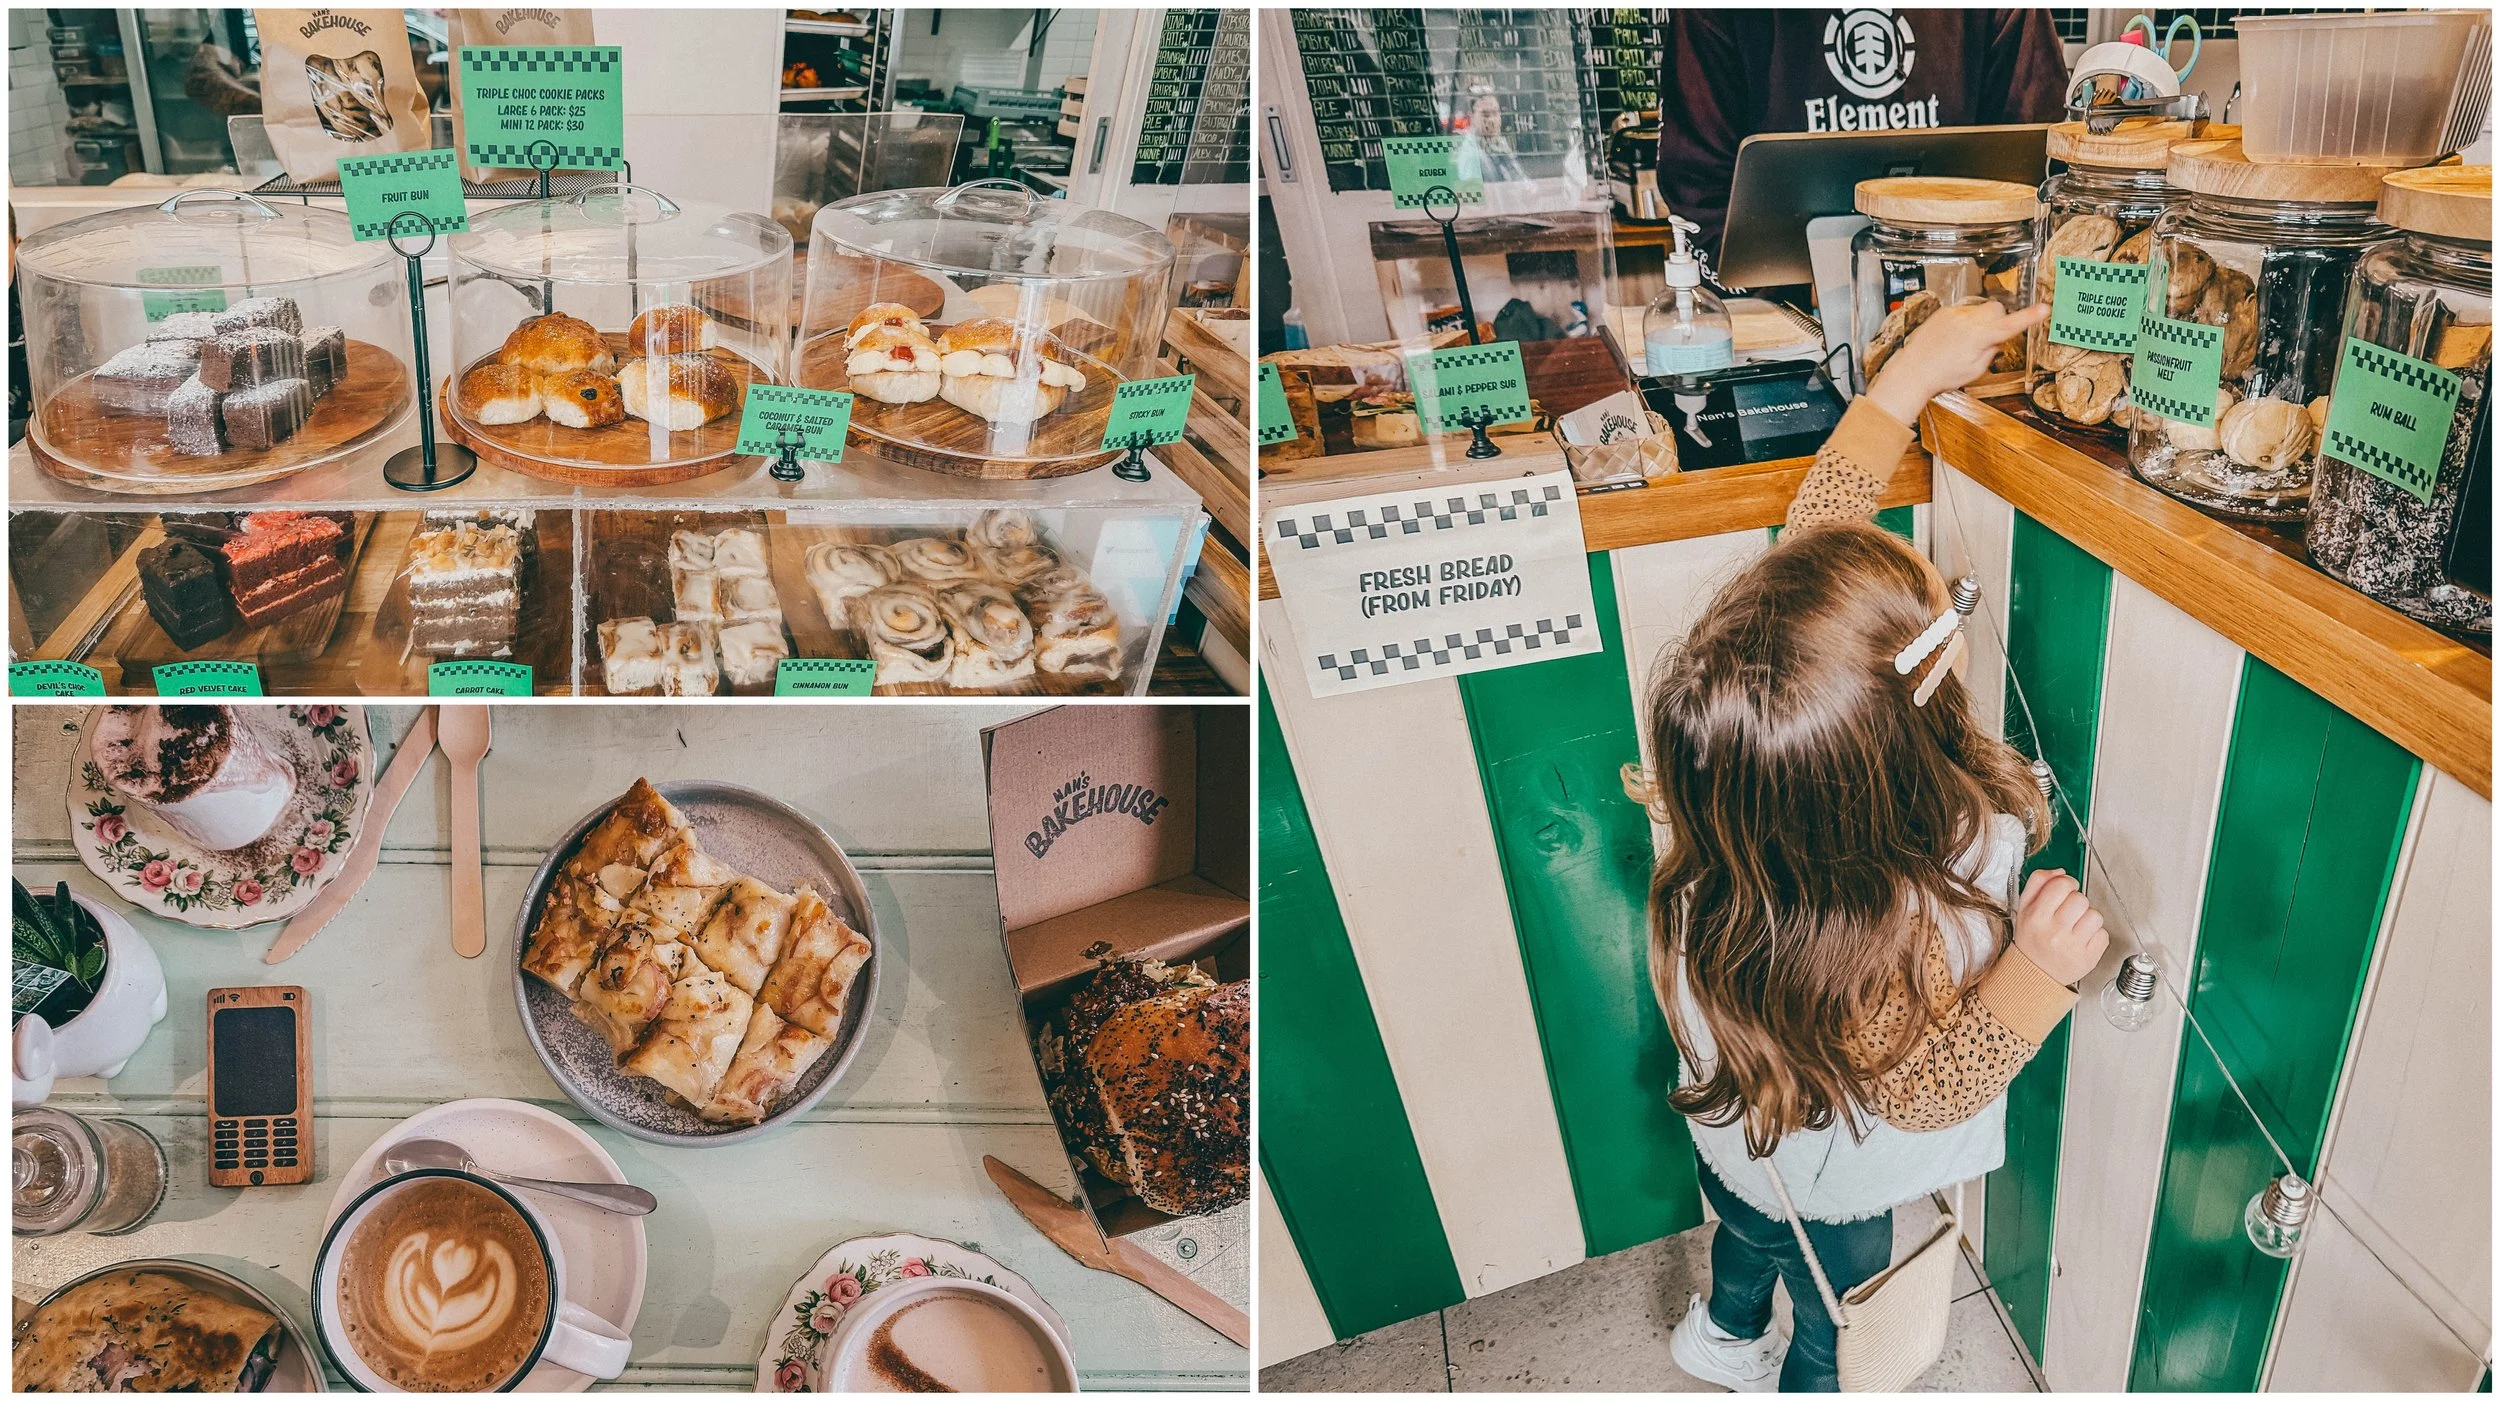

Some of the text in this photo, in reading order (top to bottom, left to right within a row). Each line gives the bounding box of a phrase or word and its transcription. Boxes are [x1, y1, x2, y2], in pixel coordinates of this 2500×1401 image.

[299, 15, 372, 39] BAKEHOUSE
[476, 88, 605, 101] TRIPLE CHOC COOKIE PACKS
[1308, 78, 1341, 96] JOHN
[497, 105, 586, 117] LARGE 6 PACK: $25
[1147, 100, 1171, 113] JOHN
[1313, 101, 1340, 118] ALE
[1804, 93, 1940, 134] Element
[500, 119, 584, 132] MINI 12 PACK: $30
[1144, 116, 1161, 129] ALE
[1419, 168, 1447, 178] REUBEN
[381, 190, 430, 203] FRUIT BUN
[2078, 292, 2128, 307] TRIPLE CHOC
[2077, 303, 2126, 318] CHIP COOKIE
[2147, 351, 2192, 372] PASSIONFRUIT
[2157, 368, 2175, 382] MELT
[1458, 385, 1464, 396] &
[1465, 382, 1498, 394] PEPPER
[1500, 379, 1517, 390] SUB
[759, 411, 834, 427] COCONUT & SALTED
[1129, 408, 1166, 420] STICKY BUN
[1697, 401, 1809, 422] Nan's Bakehouse
[2370, 401, 2417, 432] RUM BALL
[805, 425, 824, 435] BUN
[1600, 415, 1637, 446] BAKEHOUSE
[1360, 554, 1514, 593] FRESH BREAD
[1361, 574, 1522, 619] (FROM FRIDAY)
[36, 682, 86, 692] DEVIL'S CHOC
[55, 689, 75, 697] CAKE
[179, 684, 248, 696] RED VELVET CAKE
[455, 686, 505, 696] CARROT CAKE
[792, 682, 849, 690] CINNAMON BUN
[1052, 770, 1091, 803] NAN'S
[1024, 783, 1170, 860] BAKEHOUSE
